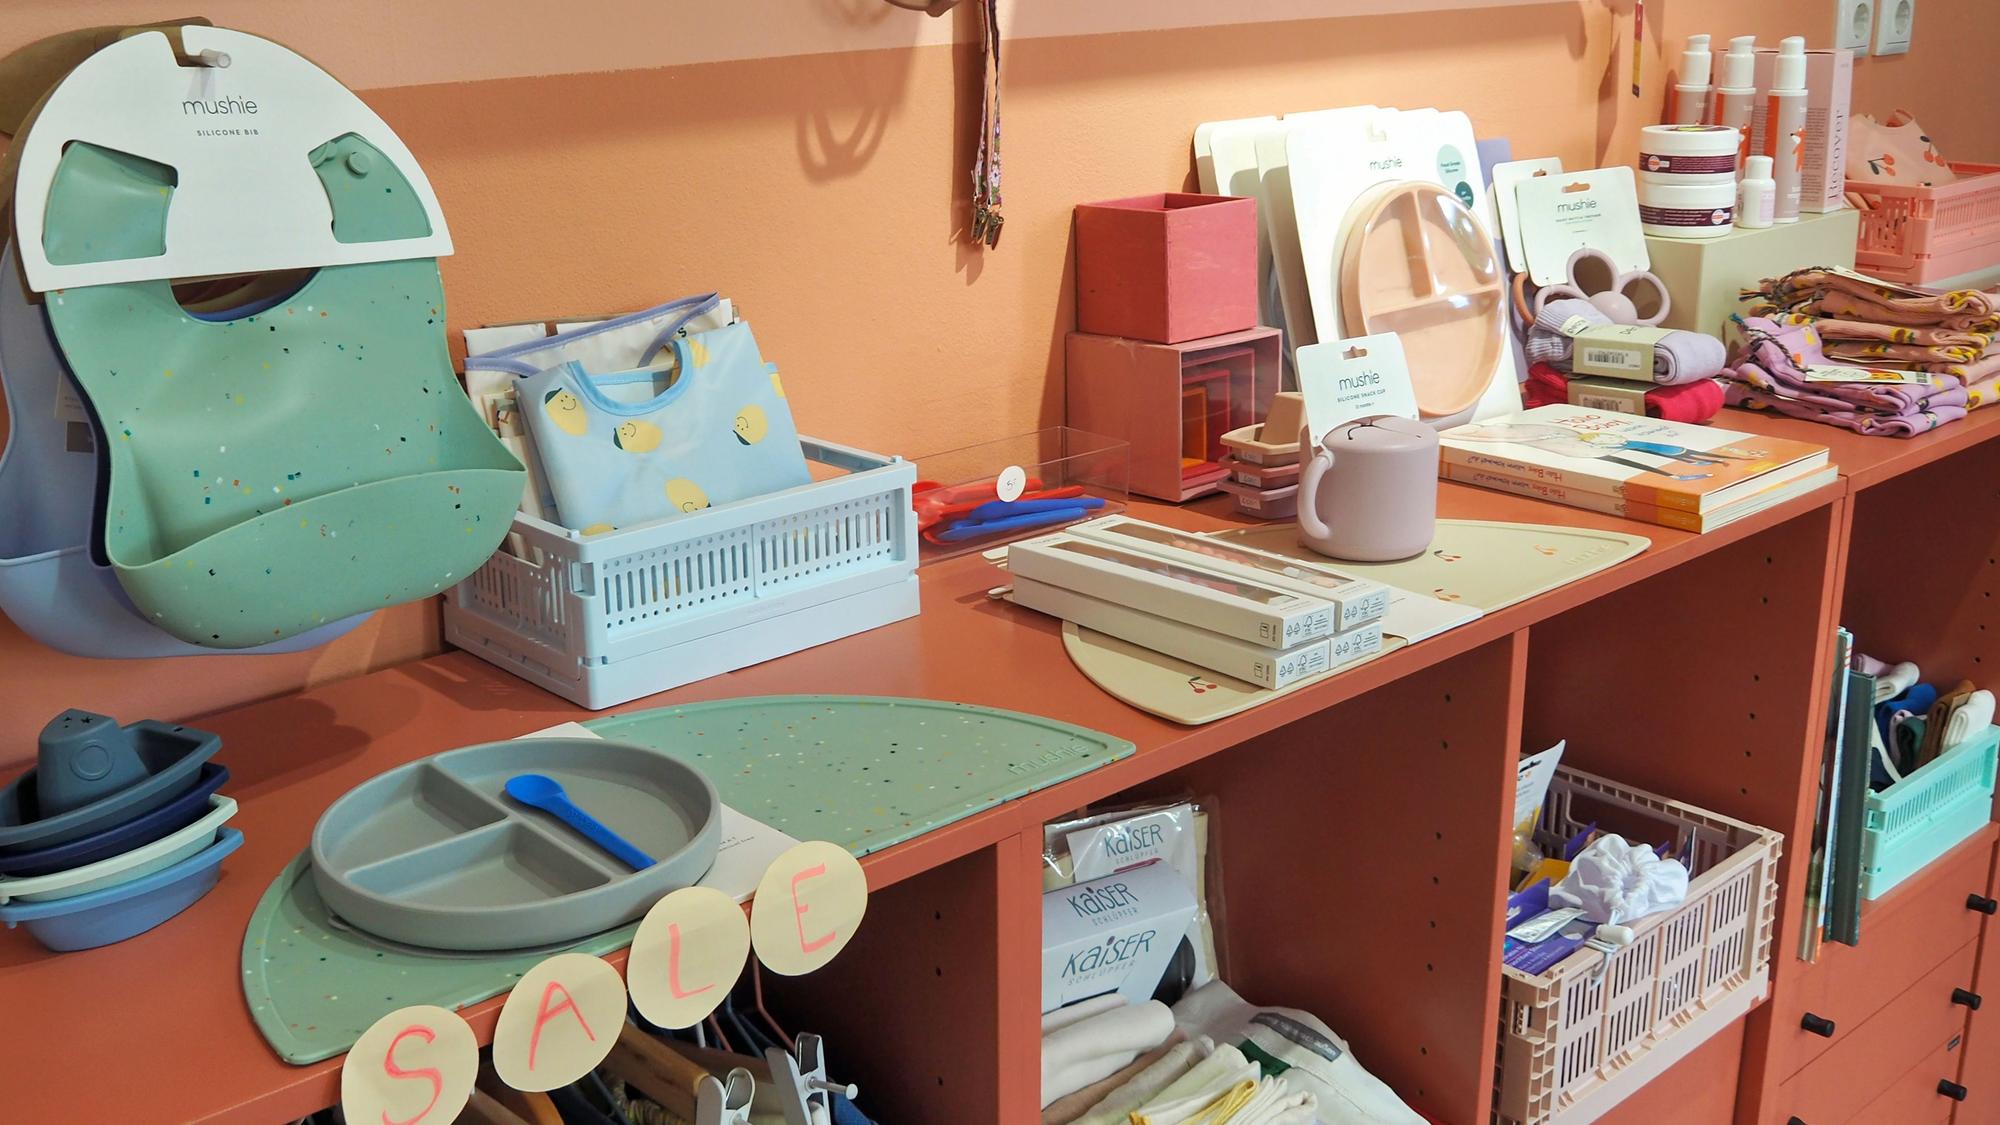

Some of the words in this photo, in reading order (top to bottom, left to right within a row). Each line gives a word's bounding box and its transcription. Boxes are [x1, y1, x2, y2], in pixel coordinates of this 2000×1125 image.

[182, 95, 258, 115] mushie
[196, 129, 241, 137] SILICONE
[244, 128, 259, 136] BIB
[1369, 156, 1403, 171] mushie
[1557, 197, 1598, 212] mushie
[1338, 369, 1380, 391] mushie
